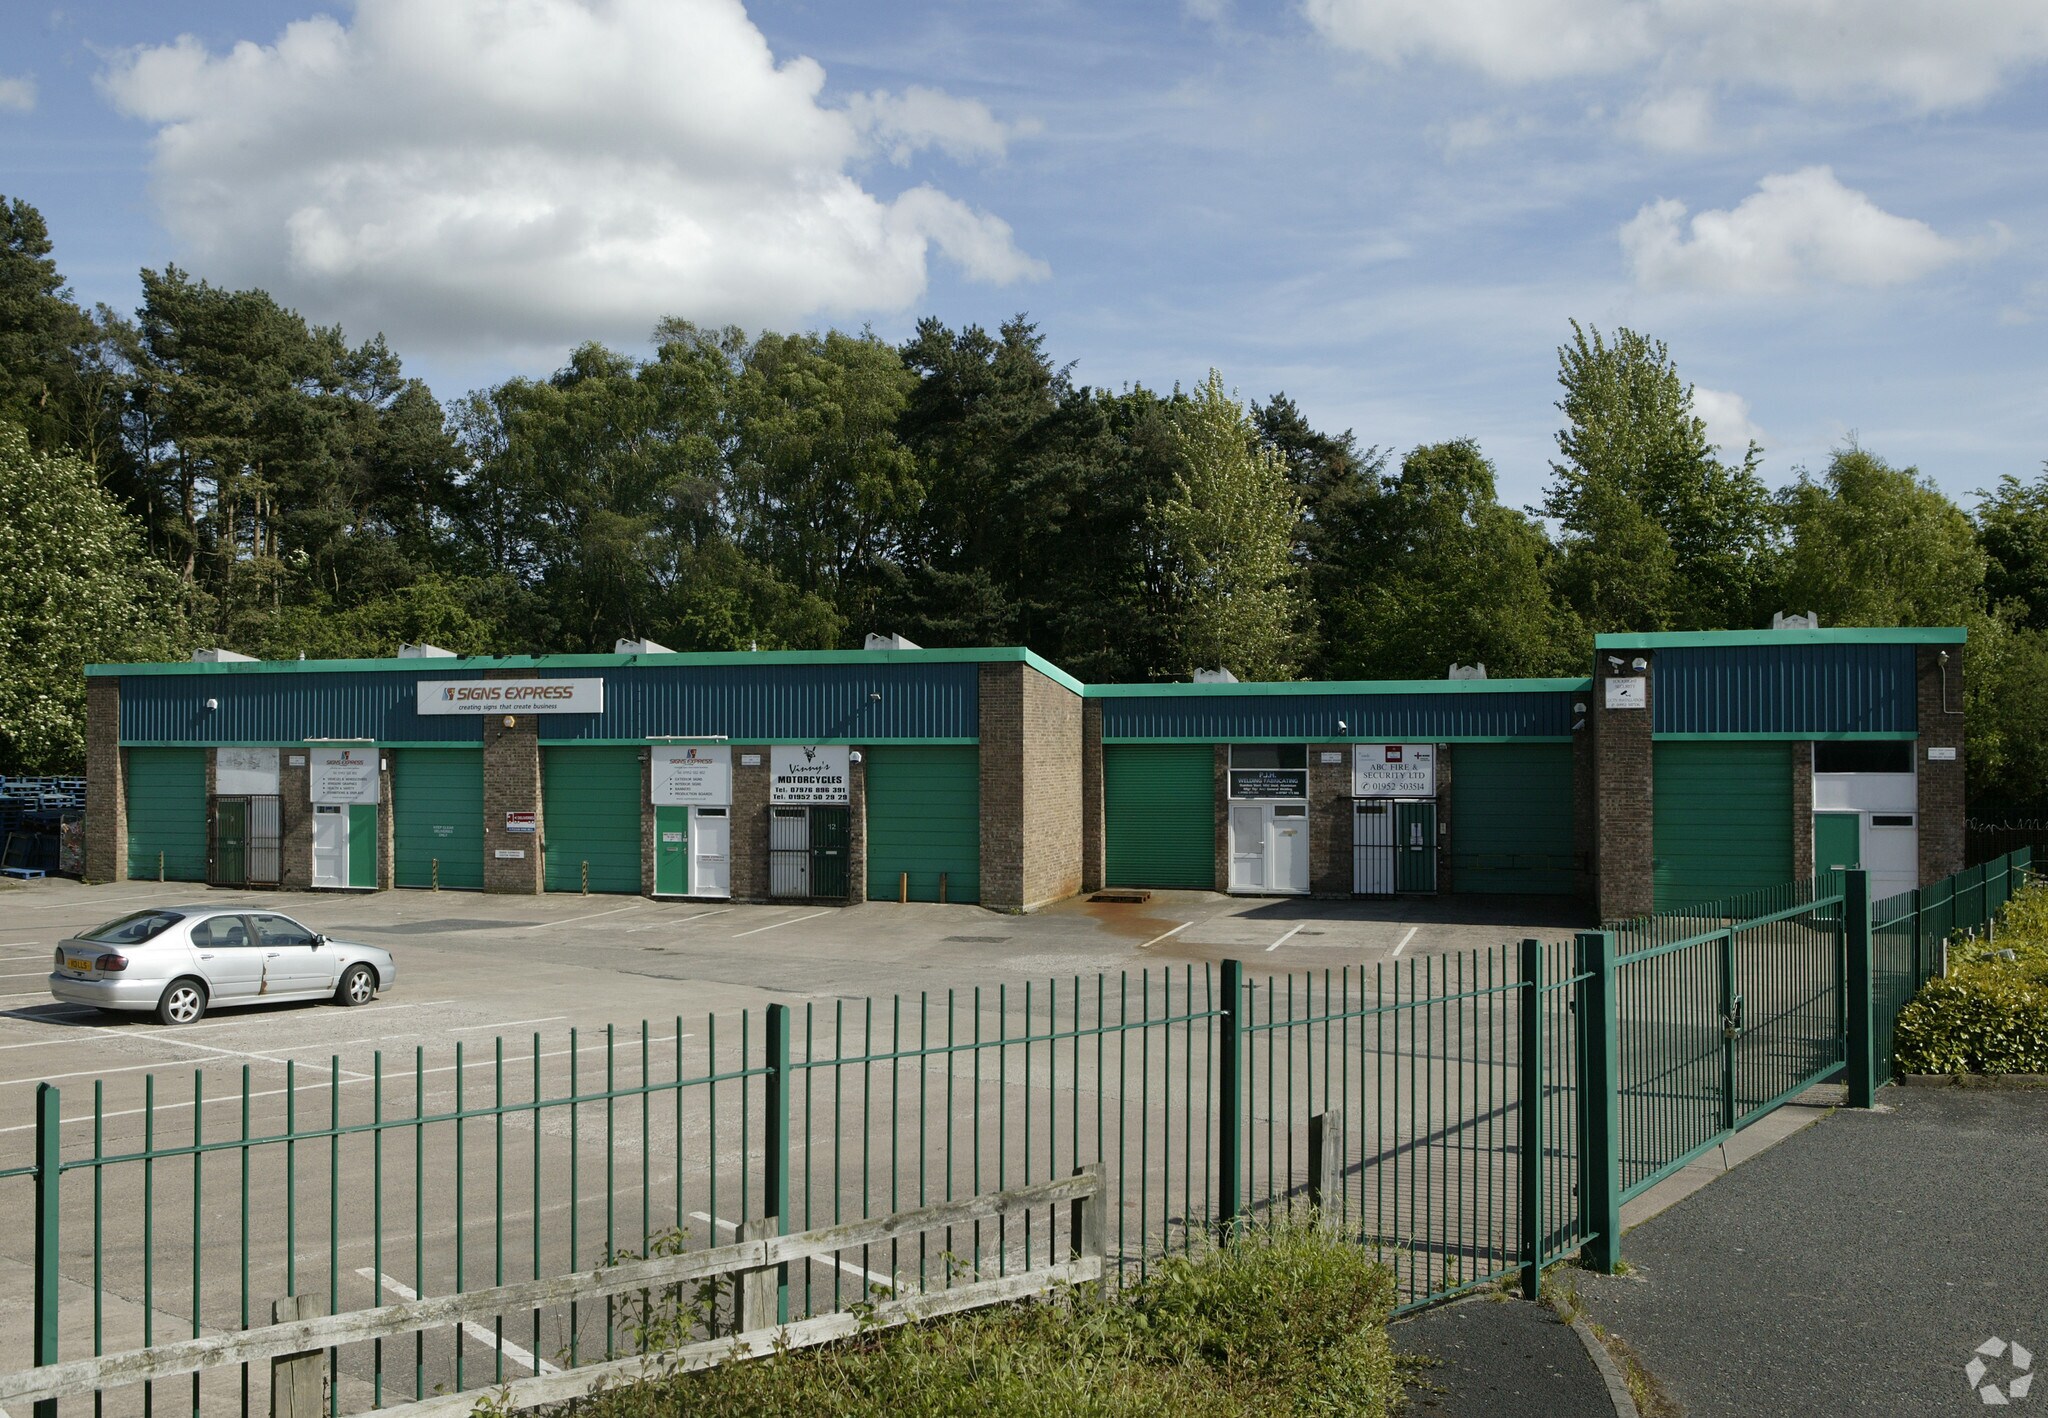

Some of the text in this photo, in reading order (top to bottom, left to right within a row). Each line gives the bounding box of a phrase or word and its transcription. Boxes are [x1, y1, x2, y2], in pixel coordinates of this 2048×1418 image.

[457, 686, 574, 701] SIGNS EXPRESS
[458, 704, 482, 712] creating
[789, 761, 831, 774] Vinny's
[777, 776, 842, 784] MOTORCYCLES
[1372, 782, 1425, 791] 01952 503514
